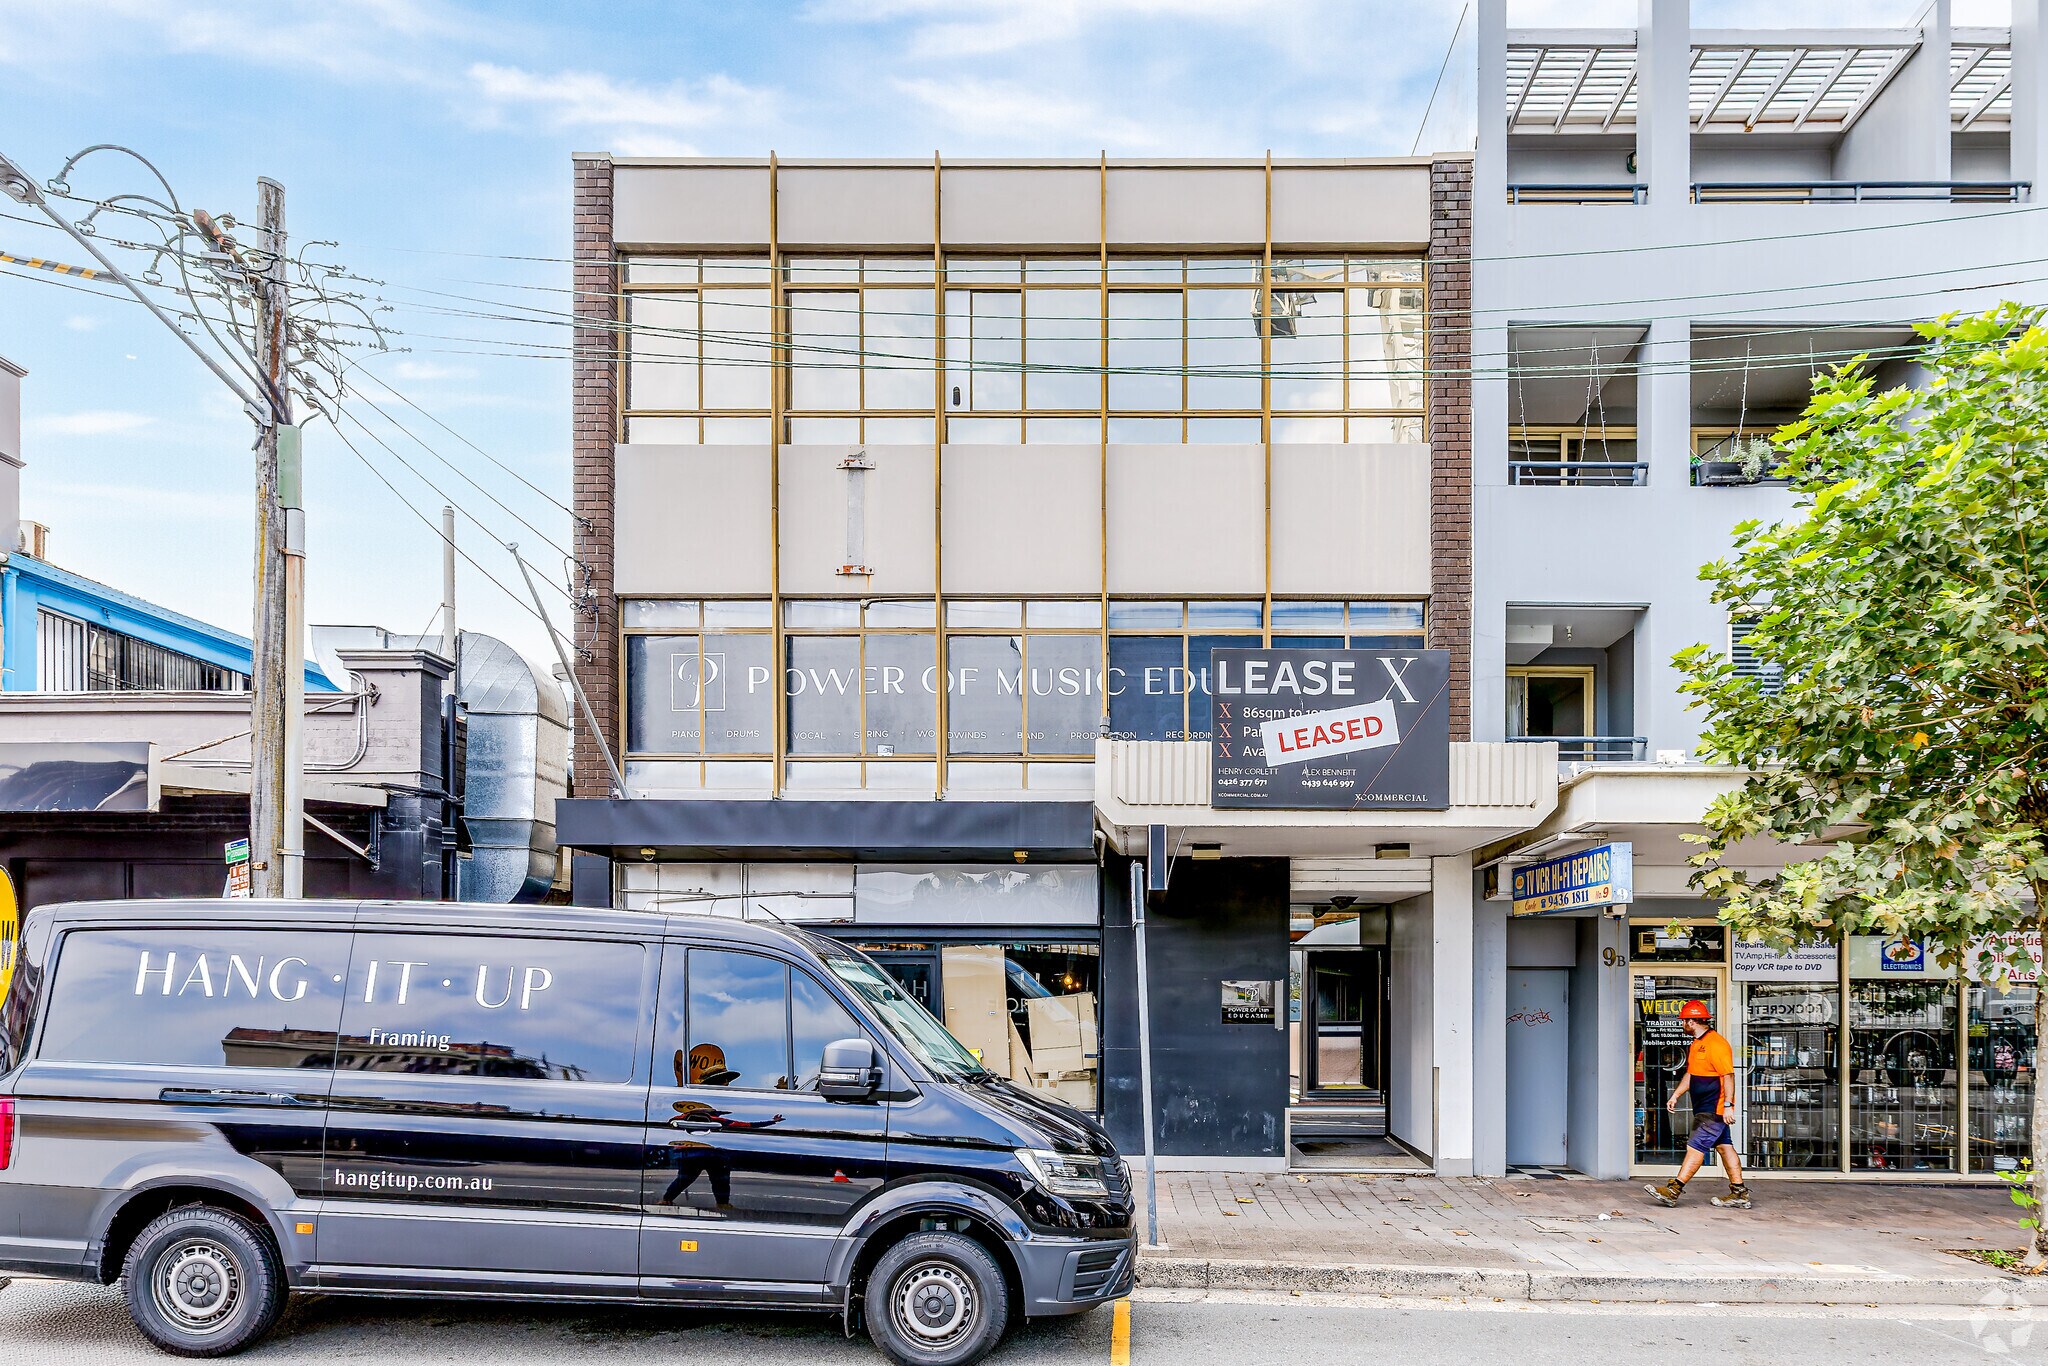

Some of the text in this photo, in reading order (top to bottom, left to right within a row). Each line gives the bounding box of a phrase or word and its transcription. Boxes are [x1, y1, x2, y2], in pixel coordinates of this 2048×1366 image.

[748, 665, 1212, 696] POWER OF MUSIC EDU
[1218, 657, 1420, 703] LEASE X
[1243, 707, 1286, 721] 86sqm
[1289, 708, 1302, 718] to
[671, 730, 701, 738] PIANO
[726, 730, 760, 738] DRUMS
[853, 731, 889, 739] SRING
[917, 730, 987, 739] WODWINDS
[1165, 731, 1212, 739] RECORDIN
[1278, 716, 1383, 753] LEASED
[1244, 768, 1279, 776] CORLETT
[1239, 779, 1253, 787] 377
[1254, 778, 1268, 787] 671
[1301, 779, 1321, 787] 0439
[1339, 779, 1355, 788] 997
[1354, 793, 1428, 802] XCOMMERCIAL
[1526, 870, 1535, 896] TV
[1535, 866, 1550, 894] VCR
[1551, 861, 1570, 891] HI-FI
[1572, 850, 1609, 887] REPAIRS
[1548, 892, 1569, 908] 9436
[1571, 889, 1589, 904] 1811
[1602, 886, 1609, 898] 9
[1795, 952, 1836, 960] accessories
[1735, 963, 1755, 972] Copy
[1758, 963, 1775, 971] VCR
[1776, 964, 1793, 972] tape
[1804, 963, 1822, 971] DVD
[1883, 963, 1922, 971] ELECTRONICS
[134, 950, 553, 1010] HANG IT UP
[369, 1027, 450, 1051] Framing
[335, 1169, 493, 1191] hangitup.com.au
